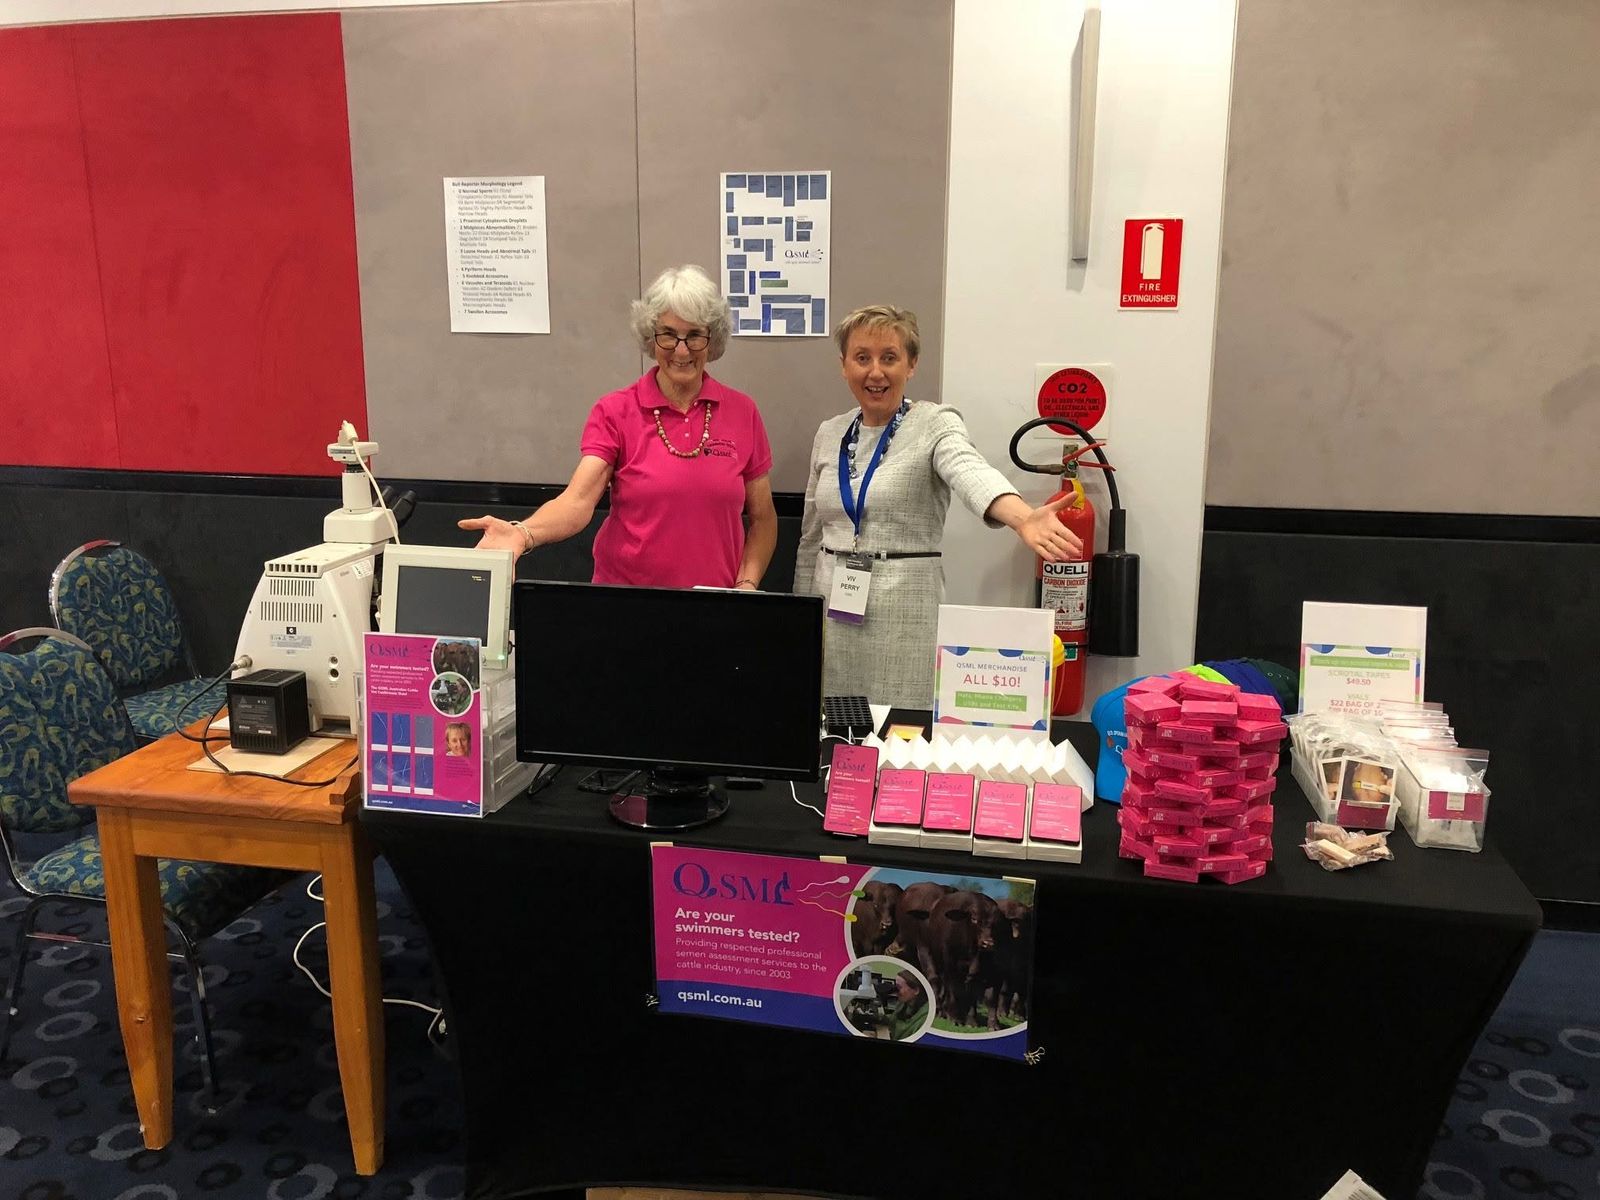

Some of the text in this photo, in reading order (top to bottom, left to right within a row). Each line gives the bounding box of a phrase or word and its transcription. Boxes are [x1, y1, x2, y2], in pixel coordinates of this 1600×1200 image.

[1122, 294, 1176, 302] EXTINGUISHER
[1058, 383, 1088, 393] CO2
[1044, 564, 1087, 575] QUELL
[840, 583, 860, 591] PERRY
[977, 663, 1028, 672] MERCHANDISE
[963, 674, 1021, 688] ALL $10!
[675, 907, 736, 925] Are your
[675, 922, 801, 944] swimmers tested?
[676, 938, 822, 959] Providing respected professional
[677, 961, 702, 969] cattle
[704, 963, 742, 975] industry,
[743, 967, 766, 977] since
[708, 952, 759, 964] assessment
[761, 958, 797, 969] services
[800, 961, 810, 970] to
[812, 962, 827, 972] the
[678, 990, 762, 1009] qsml.com.au
